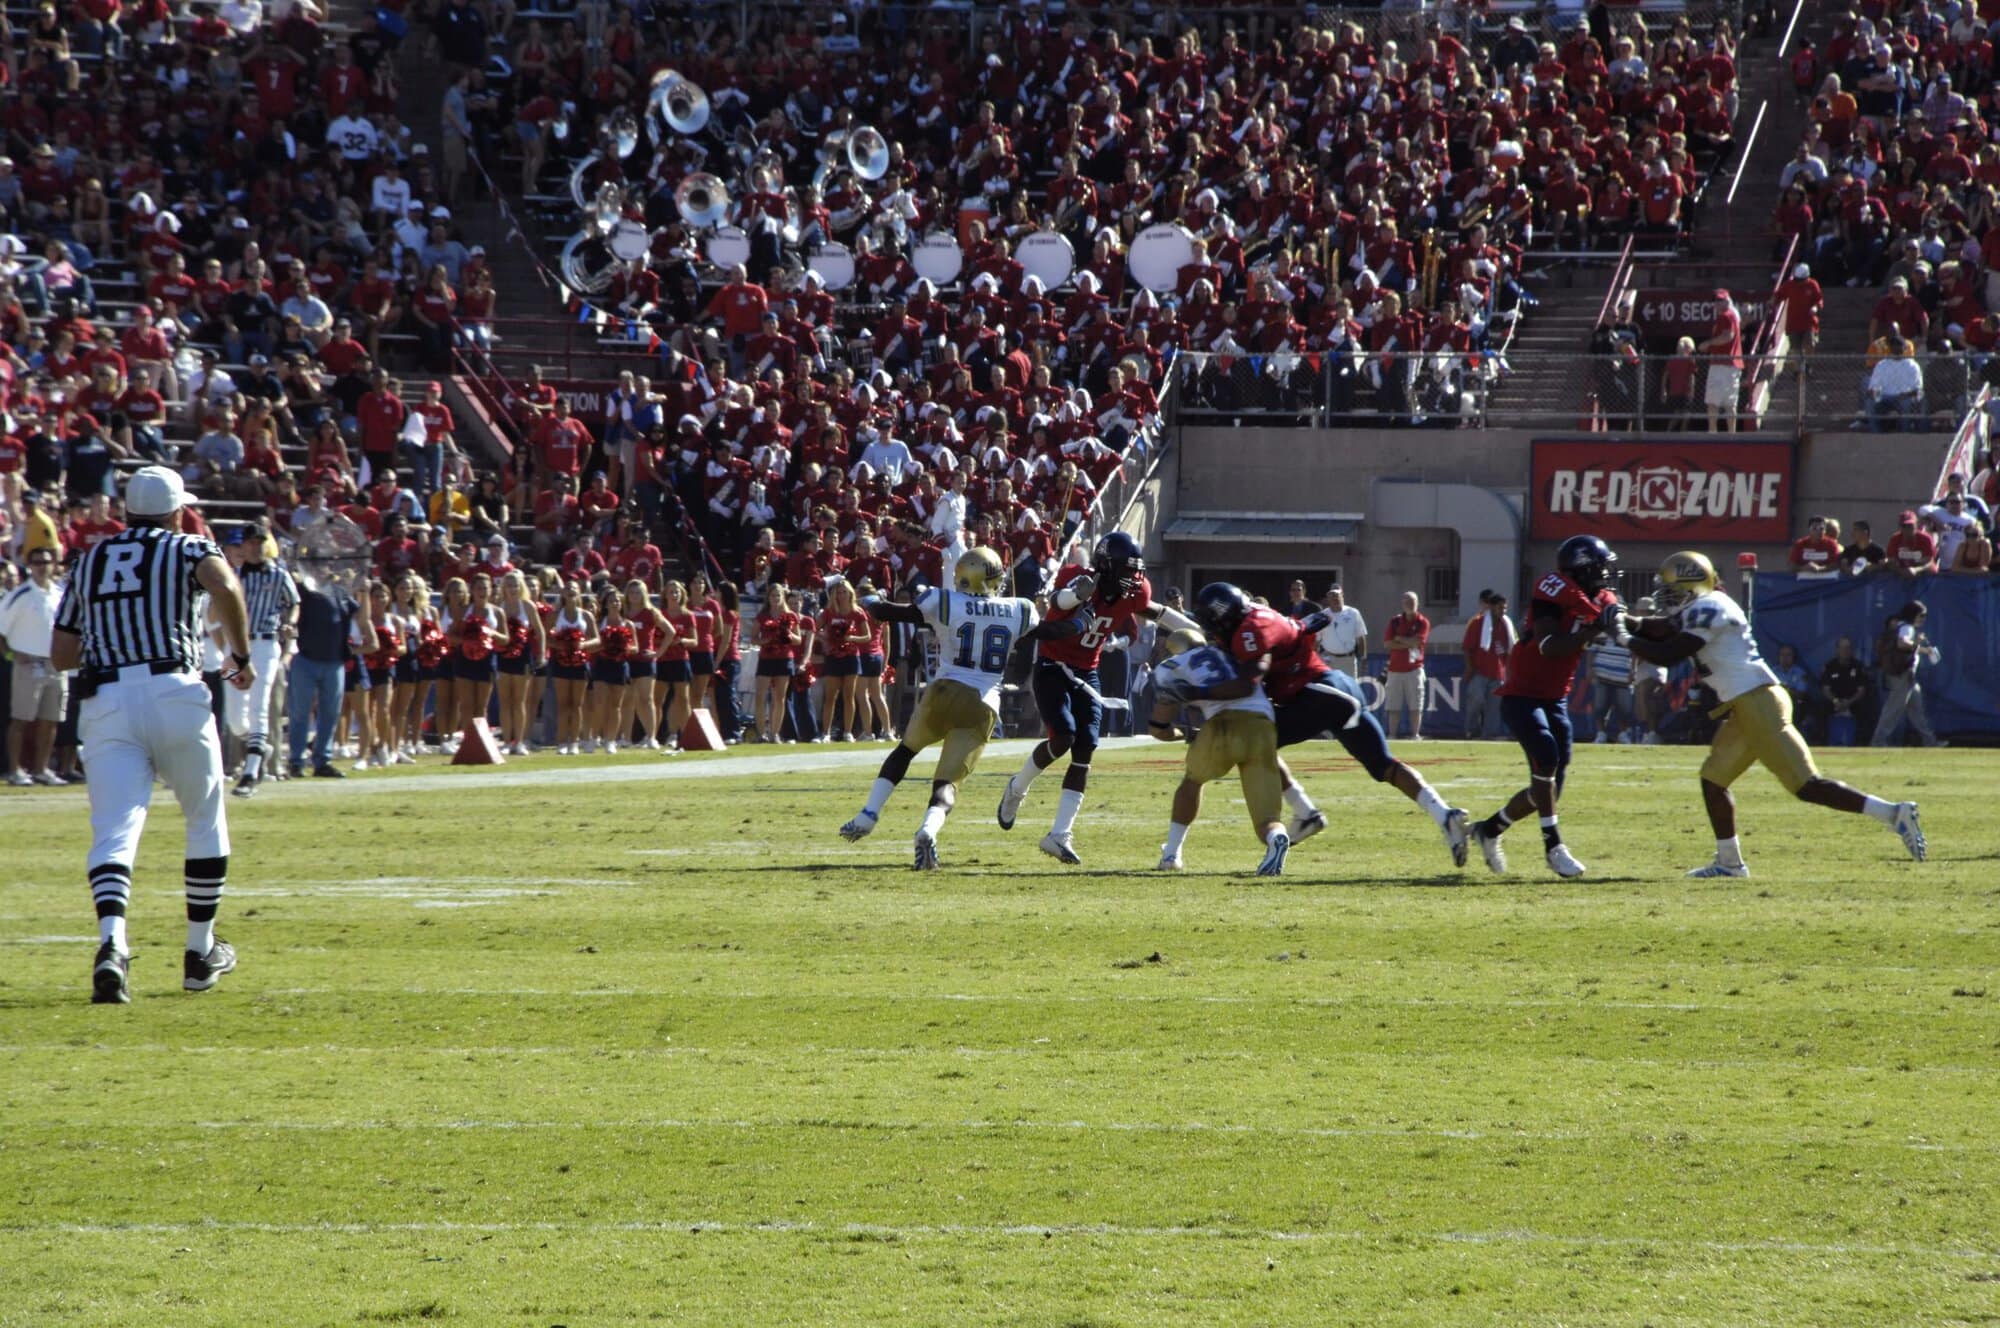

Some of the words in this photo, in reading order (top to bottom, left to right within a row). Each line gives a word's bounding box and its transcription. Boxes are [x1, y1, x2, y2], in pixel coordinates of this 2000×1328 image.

[344, 131, 367, 152] 32
[1659, 303, 1675, 321] 10
[1680, 302, 1718, 321] SECT
[1551, 470, 1632, 514] RED
[1683, 472, 1781, 517] ZONE
[97, 541, 146, 596] R
[1538, 574, 1567, 598] 23
[965, 601, 1013, 619] SLATER
[953, 621, 1012, 674] 18
[1241, 631, 1258, 652] 2
